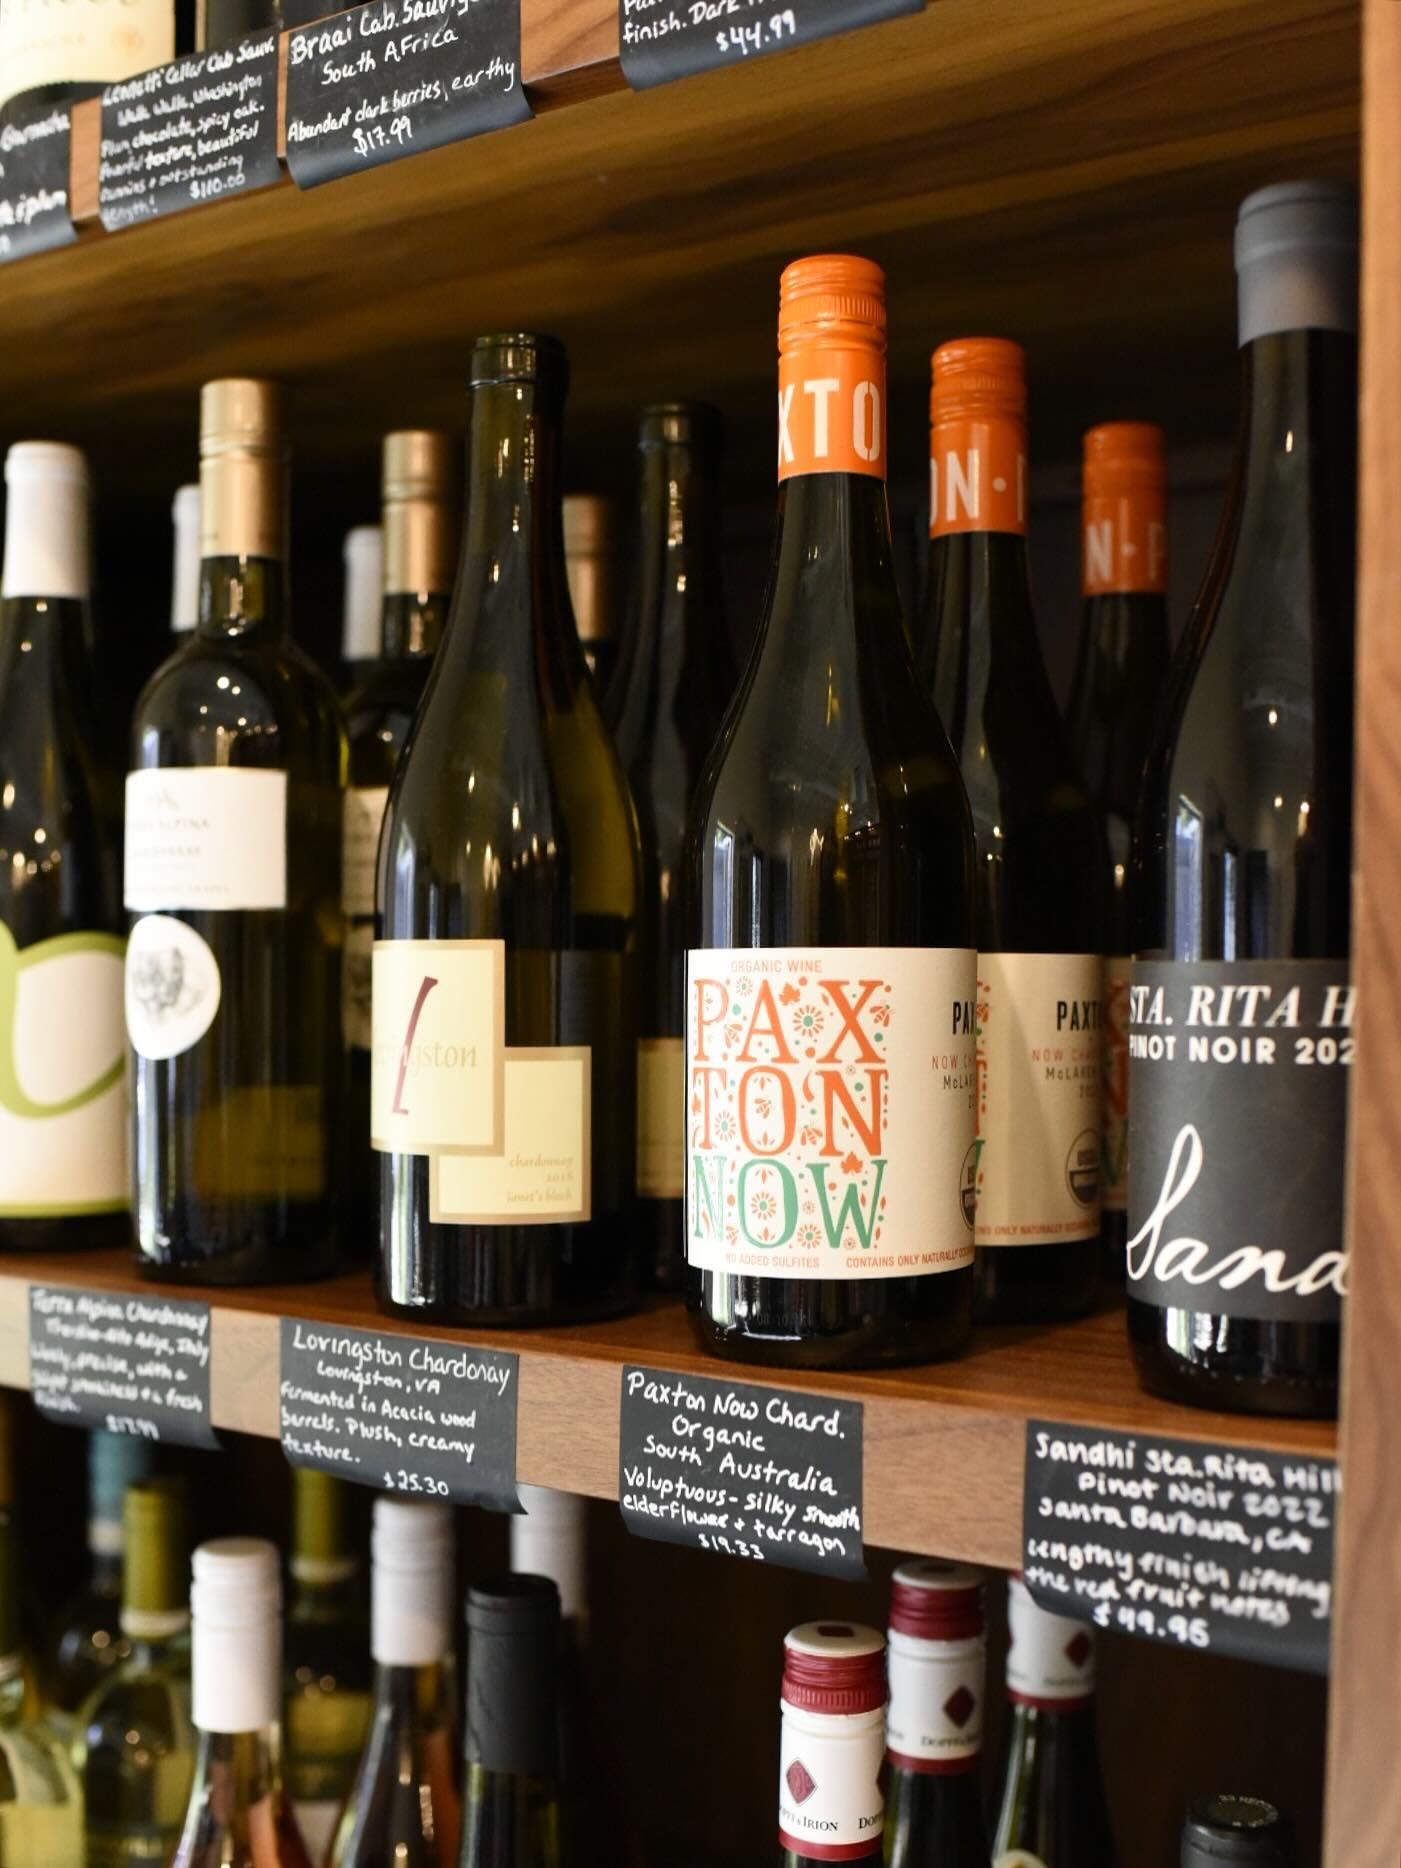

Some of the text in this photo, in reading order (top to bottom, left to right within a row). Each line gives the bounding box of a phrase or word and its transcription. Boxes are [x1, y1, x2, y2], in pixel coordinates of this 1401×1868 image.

[290, 17, 352, 65] Braai
[360, 2, 399, 36] Cab.
[622, 10, 687, 44] finish.
[716, 9, 796, 55] $44.99
[322, 50, 376, 85] South
[288, 106, 352, 142] Abundant
[355, 98, 389, 123] dark
[451, 55, 516, 92] earthy
[352, 115, 413, 157] $17.99
[190, 172, 246, 200] $110.00
[778, 378, 880, 463] XTO
[730, 959, 824, 974] ORGANIC WINE
[1056, 1000, 1099, 1033] PAXT
[1130, 985, 1173, 1025] STA.
[1185, 984, 1300, 1028] RITA
[931, 1055, 959, 1071] NOW
[1130, 1034, 1176, 1060] PINOT
[1188, 1036, 1275, 1065] NOIR
[1294, 1037, 1356, 1065] 202
[692, 1155, 888, 1249] NOW
[771, 1255, 820, 1268] SULFITES
[846, 1255, 895, 1269] CONTAINS
[897, 1253, 921, 1266] ONLY
[292, 1324, 402, 1370] Lovingston
[415, 1378, 440, 1394] VA
[628, 1371, 845, 1439] Paxton Now Chard.
[361, 1394, 376, 1413] in
[381, 1399, 436, 1424] Acacia
[440, 1410, 477, 1429] wood
[281, 1405, 475, 1463] barrels. Plush, creamy
[281, 1432, 361, 1464] texture.
[672, 1414, 765, 1452] Organic
[643, 1434, 838, 1496] South Australia
[1035, 1432, 1136, 1470] Sandhi
[1283, 1465, 1342, 1492] Hill
[744, 1491, 796, 1526] silky
[802, 1504, 861, 1531] smooth
[1077, 1472, 1330, 1528] Pinot Noir 2022
[753, 1518, 846, 1557] tarragon
[1038, 1497, 1128, 1529] Santa
[1265, 1526, 1313, 1554] CA
[1138, 1551, 1231, 1590] finish
[1025, 1565, 1291, 1628] the red fruit notes
[803, 1815, 839, 1832] IRION
